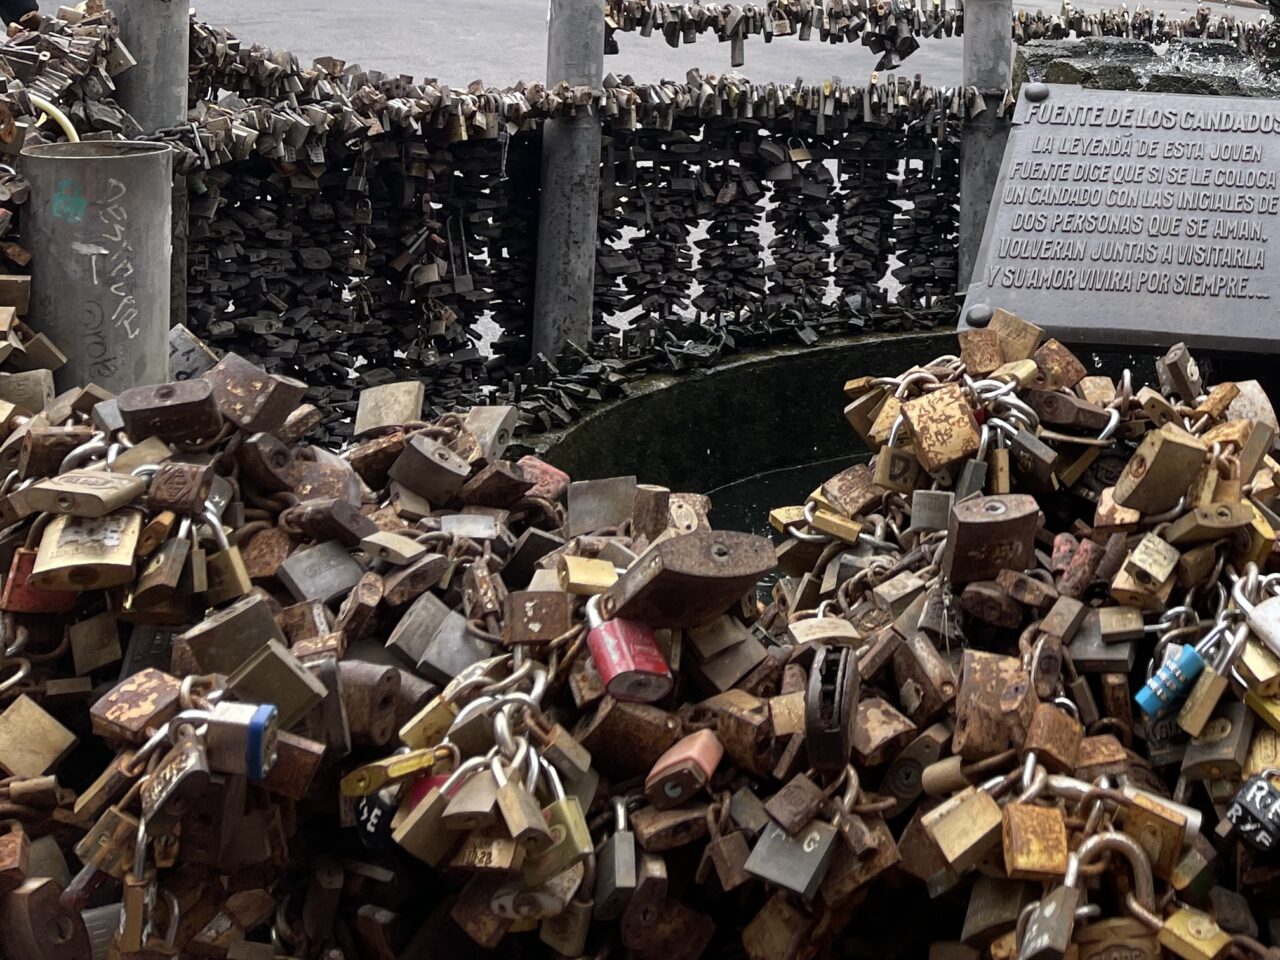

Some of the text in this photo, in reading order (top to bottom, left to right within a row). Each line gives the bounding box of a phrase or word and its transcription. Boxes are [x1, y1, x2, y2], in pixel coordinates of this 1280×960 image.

[1024, 103, 1103, 127] FUENTE
[1105, 107, 1134, 128] DE
[1135, 109, 1177, 130] LOS
[1032, 135, 1263, 163] LA LEYENDA DE ESTA JOVEN
[1009, 161, 1276, 190] FUENTE DICE QUE SI SE LE COLOCA
[1004, 185, 1279, 215] UN CANDADO CON LAS INICIALES DE
[1011, 212, 1046, 232] DOS
[1051, 214, 1143, 235] PERSONAS
[1148, 216, 1181, 238] QUE
[1186, 218, 1208, 238] SE
[998, 237, 1265, 270] VOLVERAN JUNTAS A VISITARLA
[987, 265, 1001, 288] Y
[1003, 267, 1027, 289] SU
[1027, 269, 1075, 290] AMOR
[1079, 270, 1131, 292] VIVIRA
[1136, 272, 1170, 294] POR
